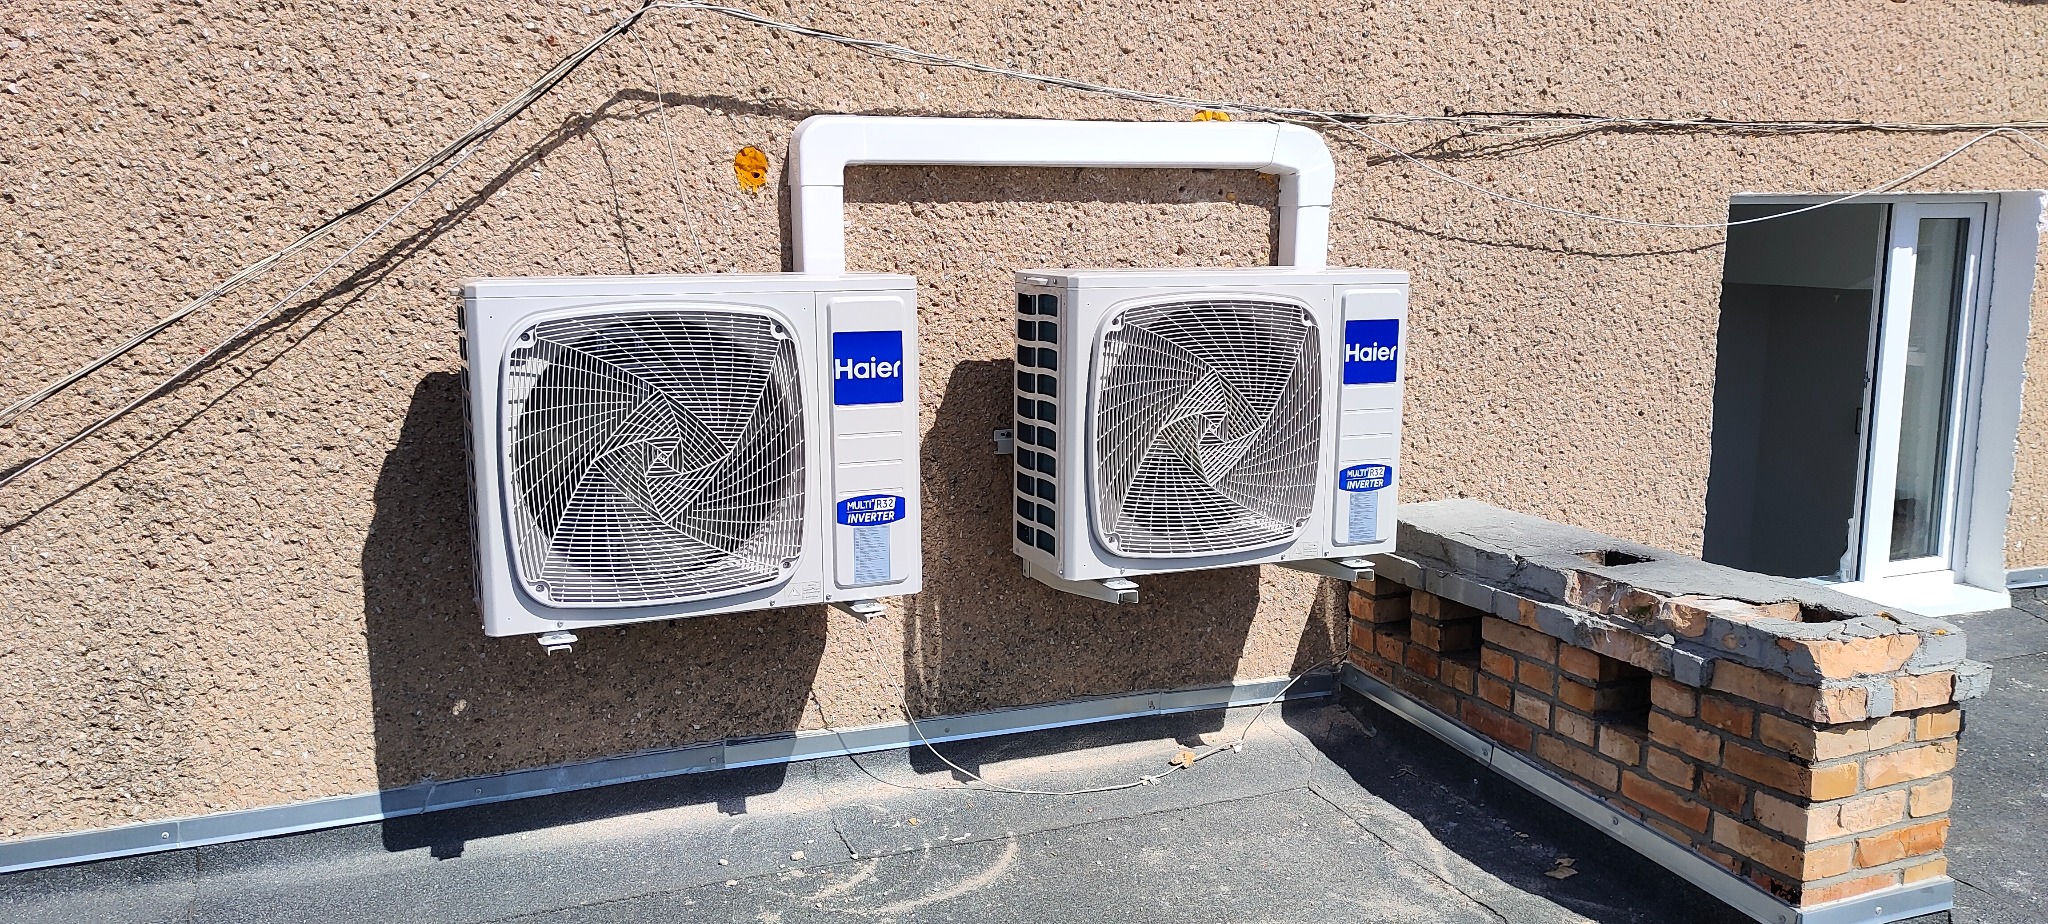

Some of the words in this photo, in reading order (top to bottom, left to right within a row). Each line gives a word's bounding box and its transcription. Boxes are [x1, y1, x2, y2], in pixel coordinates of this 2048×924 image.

[1345, 342, 1397, 362] Haier
[834, 356, 901, 380] Haier
[1369, 467, 1384, 477] R32
[1346, 478, 1384, 490] INVERTER
[876, 498, 894, 509] R32
[847, 510, 895, 524] INVERTER
